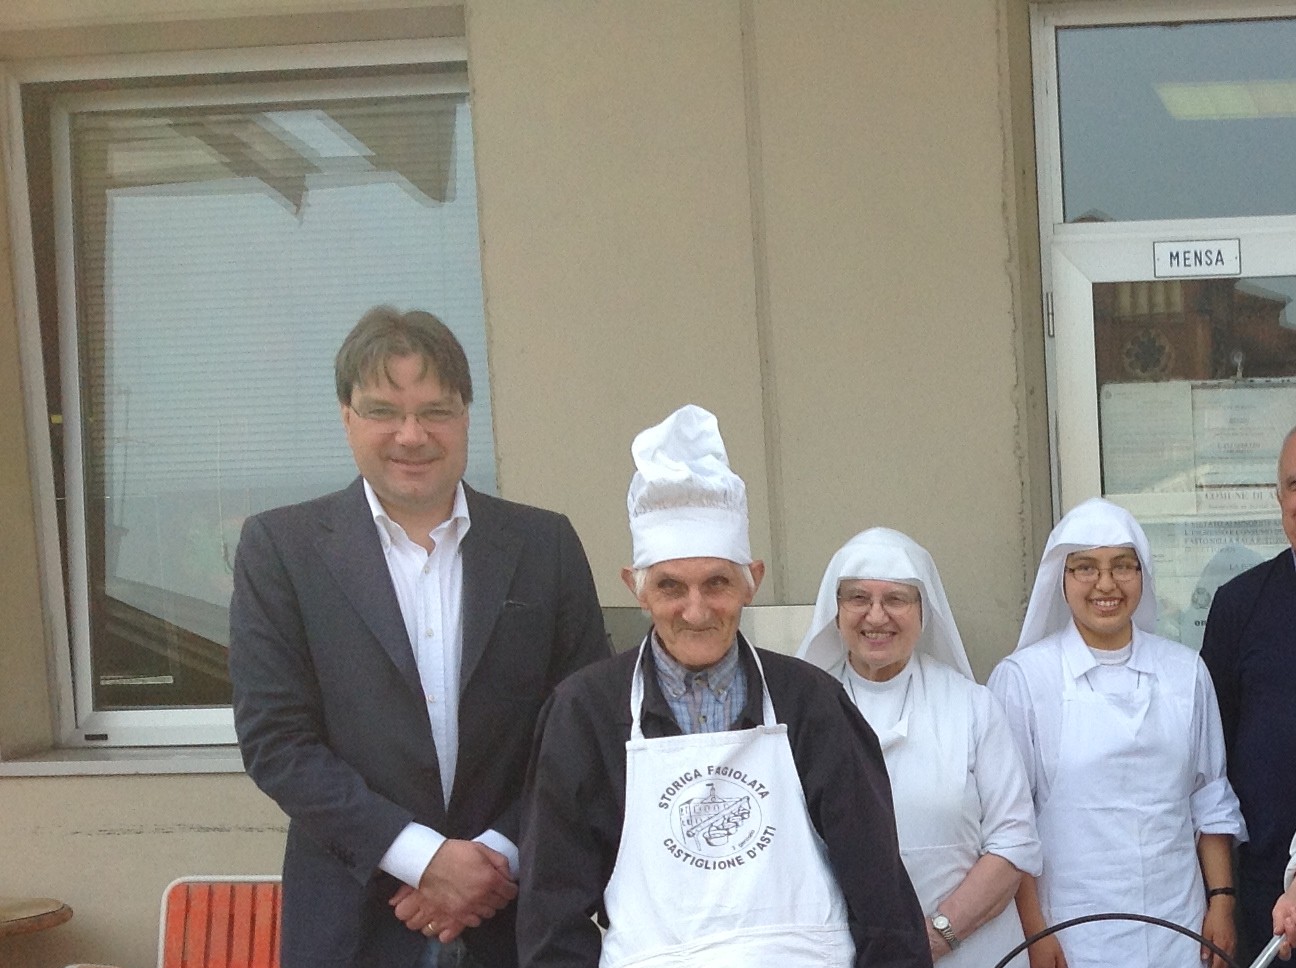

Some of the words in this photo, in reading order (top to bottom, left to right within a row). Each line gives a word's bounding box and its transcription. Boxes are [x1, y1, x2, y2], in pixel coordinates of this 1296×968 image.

[1169, 249, 1225, 268] MENSA
[658, 768, 702, 810] STORICA
[707, 765, 770, 799] FAGIOLATA
[663, 838, 745, 870] CASTIGLIONE
[746, 825, 777, 859] D'ASTI
